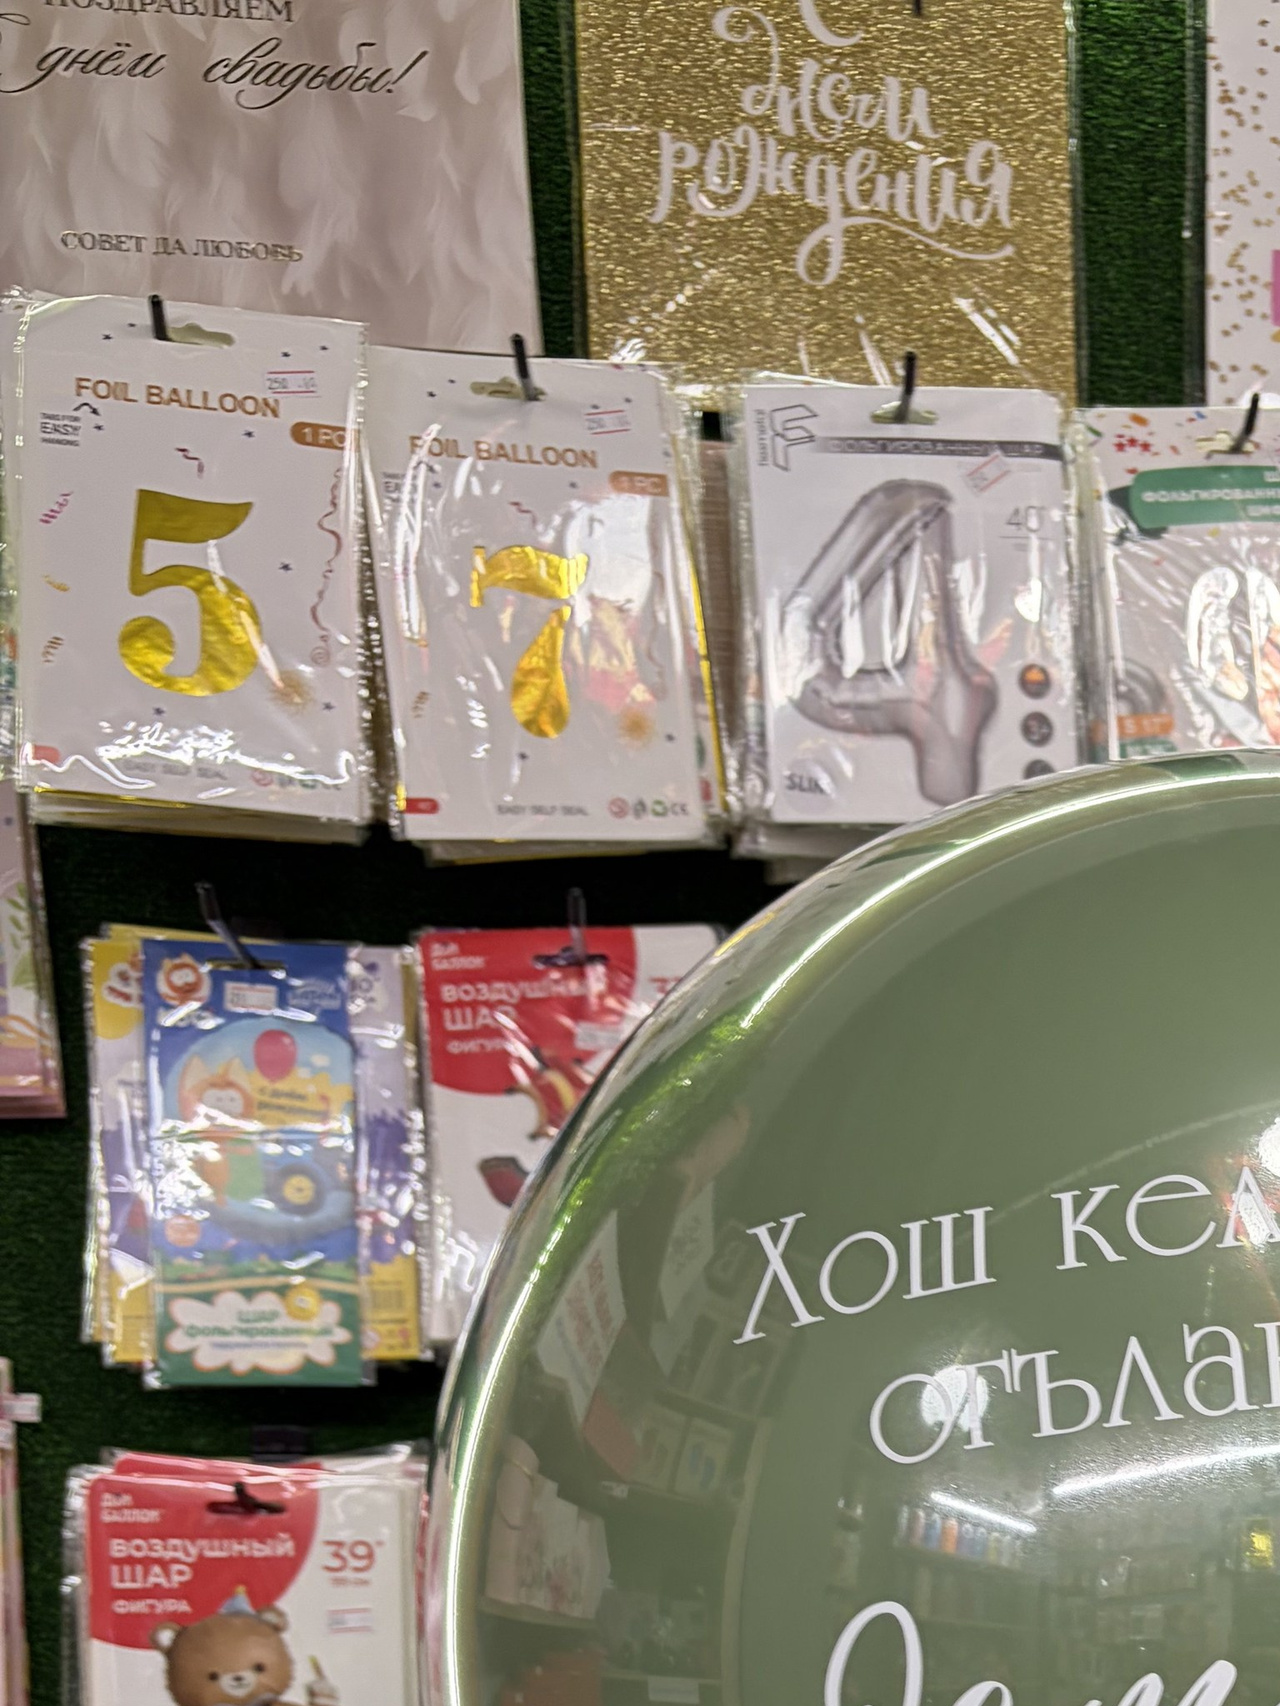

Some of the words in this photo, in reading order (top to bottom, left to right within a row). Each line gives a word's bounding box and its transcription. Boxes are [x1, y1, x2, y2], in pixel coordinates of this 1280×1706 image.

[36, 42, 168, 80] днём
[202, 36, 430, 110] свадьбы!
[712, 6, 943, 142] днём
[648, 125, 1015, 286] рождения
[61, 231, 148, 254] СОВЕТ
[153, 237, 191, 257] ДА
[193, 239, 304, 262] ЛЮБОВЬ
[74, 377, 138, 403] FOIL
[145, 384, 281, 419] BALLOON
[408, 436, 468, 459] FOIL
[473, 441, 598, 469] BALLOON
[118, 488, 263, 697] 5
[733, 1205, 997, 1344] Хош
[109, 1533, 295, 1562] ВОЗДУШНЫЙ
[110, 1565, 193, 1589] ШАР
[112, 1599, 193, 1614] ФИГУРА
